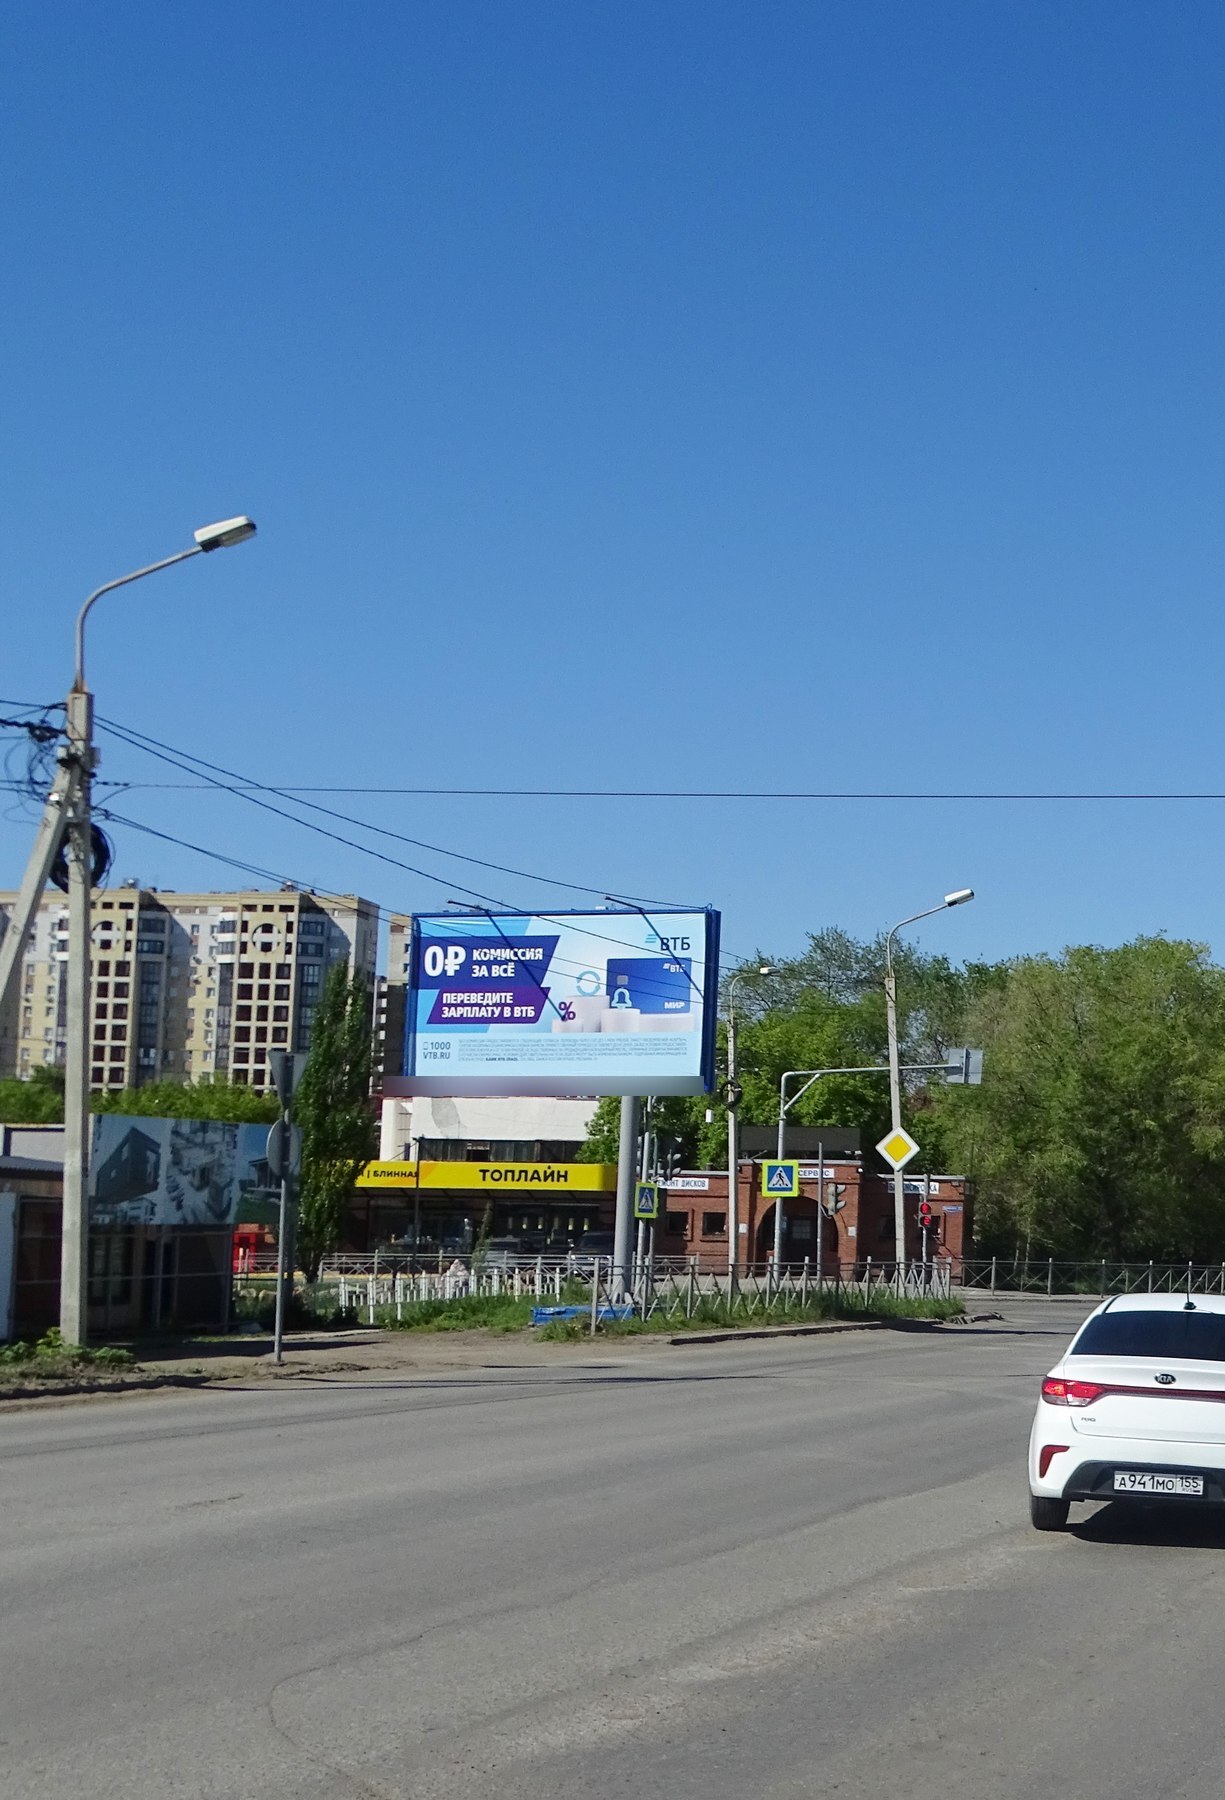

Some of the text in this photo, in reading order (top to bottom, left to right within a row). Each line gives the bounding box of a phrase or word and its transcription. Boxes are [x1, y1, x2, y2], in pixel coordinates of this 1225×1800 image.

[660, 936, 690, 951] ВТБ
[472, 948, 543, 960] КОМИССИЯ
[471, 962, 515, 977] ЗА ВСЁ
[442, 993, 514, 1005] ПЕРЕВЕДИТЕ
[664, 1001, 685, 1009] МИР
[441, 1006, 536, 1018] ЗАРПЛАТУ В ВТБ
[430, 1041, 451, 1050] 1000
[423, 1051, 451, 1060] VTB.RU
[479, 1165, 568, 1183] ТОПЛАЙН
[798, 1169, 830, 1177] СЕРВС
[657, 1179, 679, 1187] ЕМОНТ
[1118, 1474, 1199, 1491] А941МО 155
